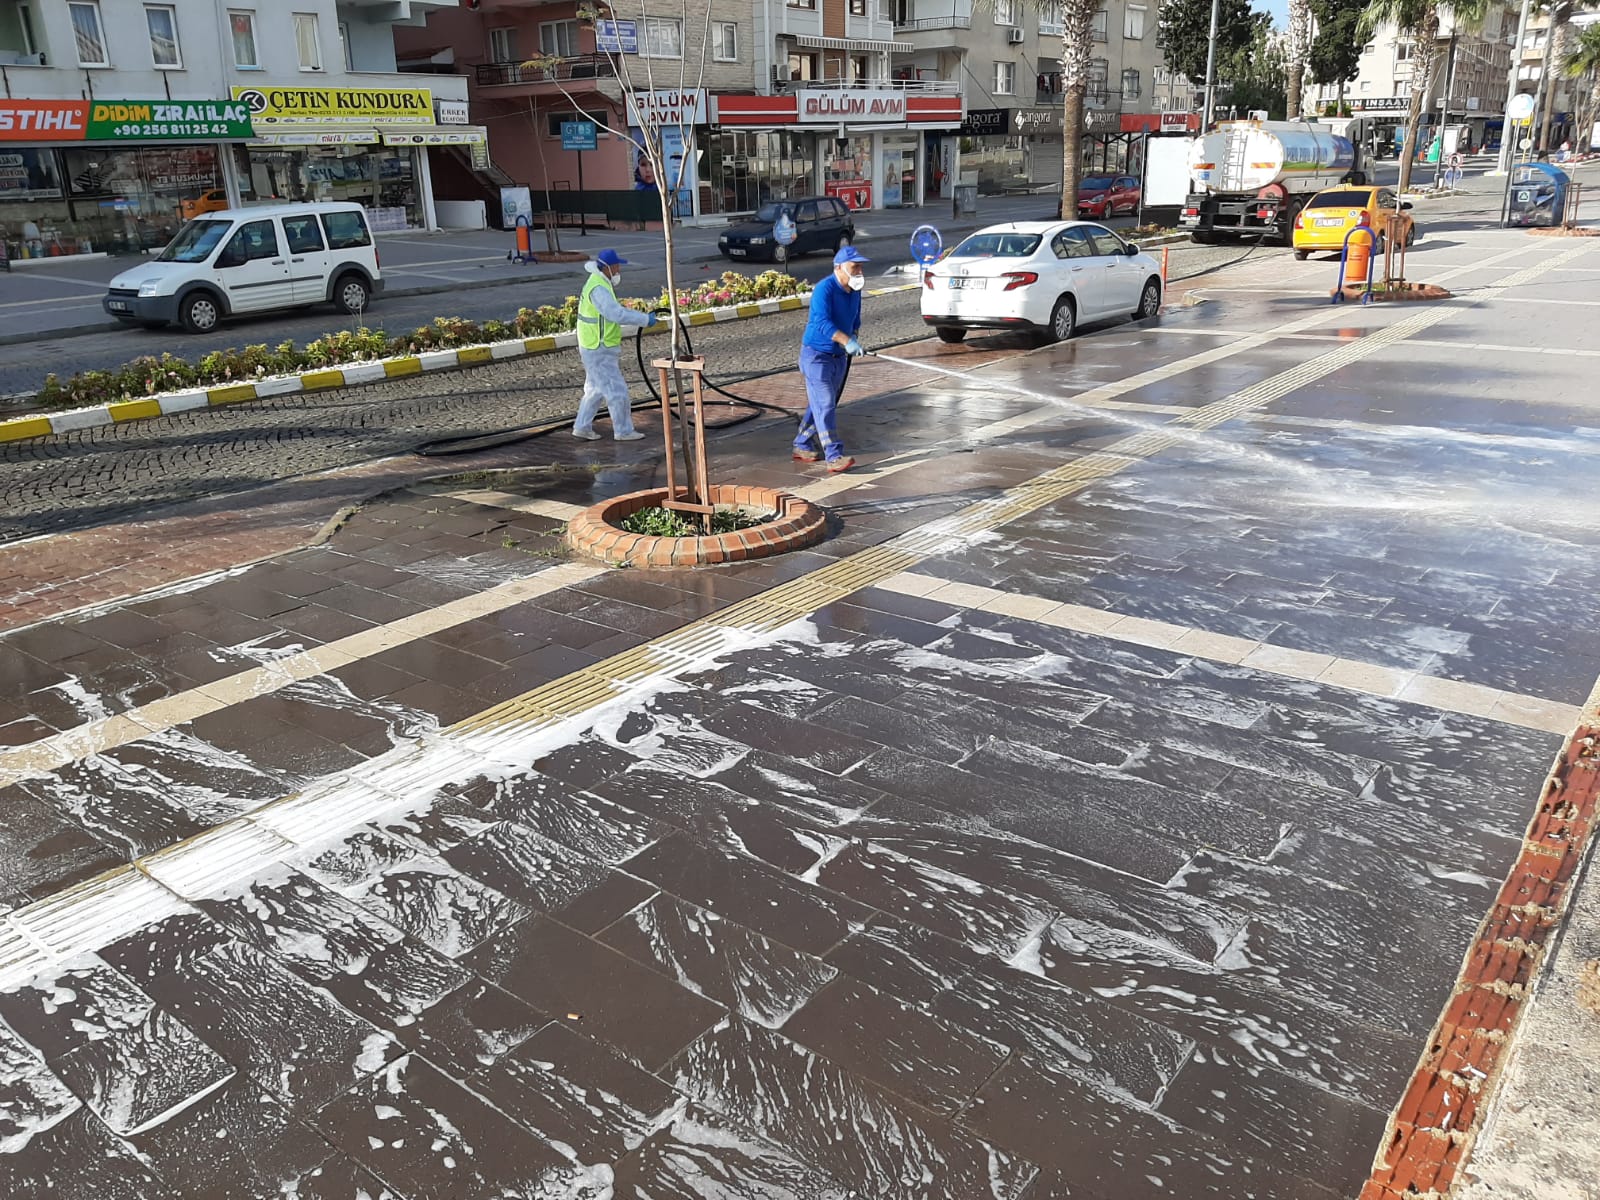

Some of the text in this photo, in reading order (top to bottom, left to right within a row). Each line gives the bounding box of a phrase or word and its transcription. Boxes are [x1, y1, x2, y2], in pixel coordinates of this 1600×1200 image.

[270, 91, 428, 113] ÇETİN KUNDURA
[636, 92, 696, 109] GÜLÜM
[806, 93, 902, 114] GÜLÜM AVM
[0, 110, 82, 130] STIHL
[93, 104, 247, 124] DİDİM ZİRAİ İLAÇ
[648, 111, 685, 123] AVM
[1025, 112, 1051, 128] angora
[114, 123, 228, 136] +90 256 811 25 42
